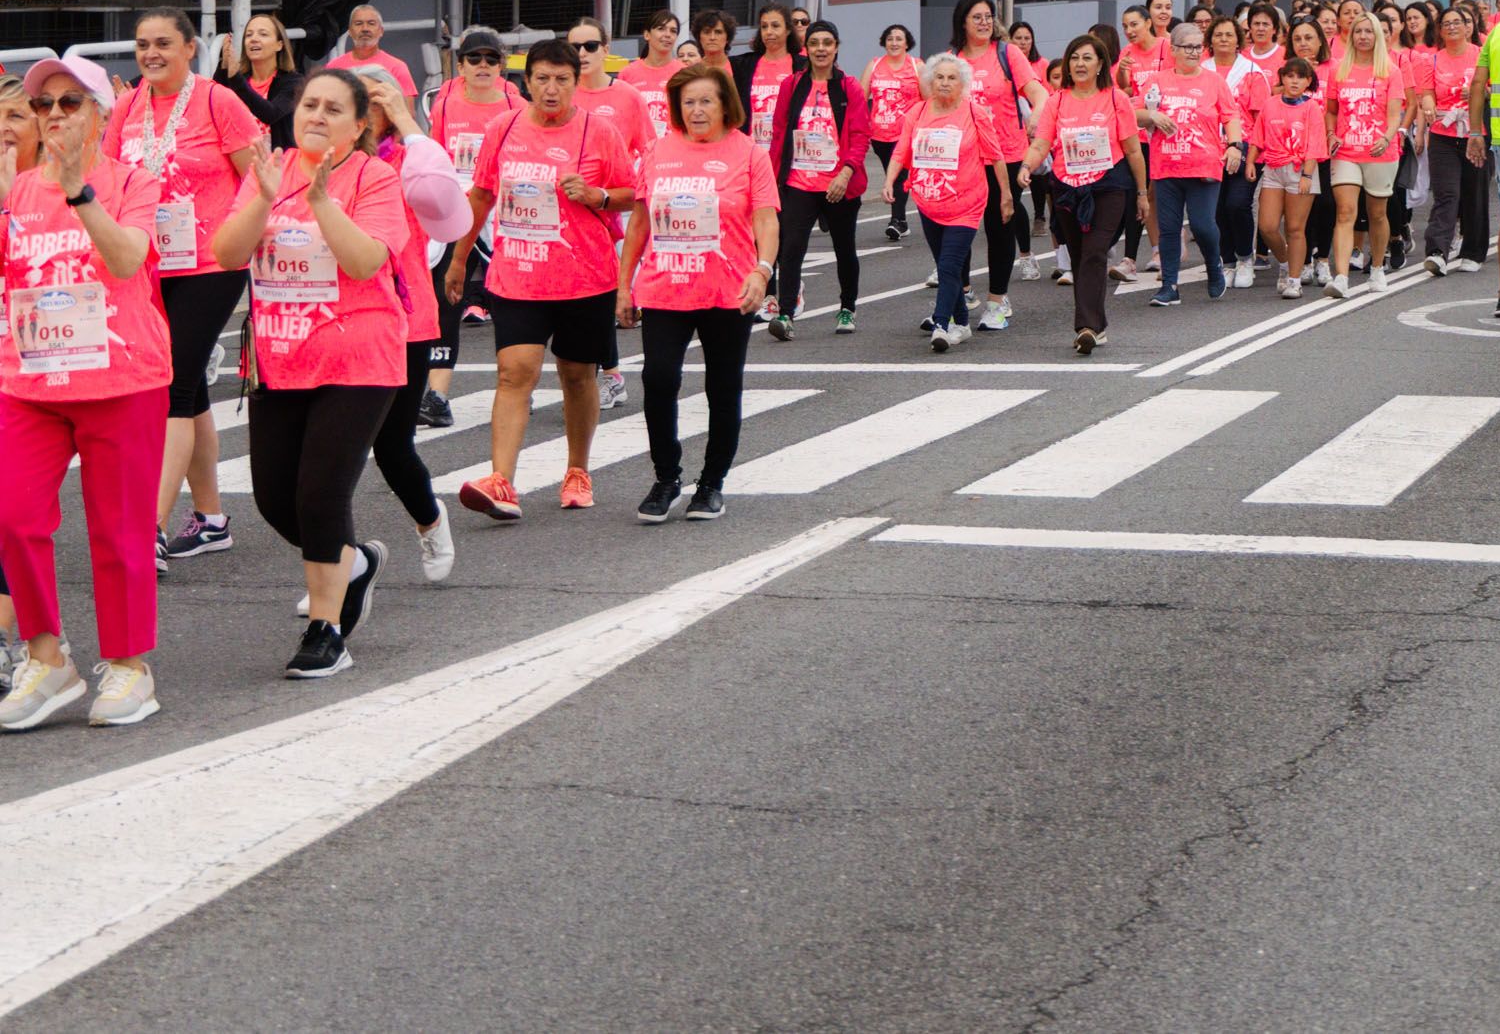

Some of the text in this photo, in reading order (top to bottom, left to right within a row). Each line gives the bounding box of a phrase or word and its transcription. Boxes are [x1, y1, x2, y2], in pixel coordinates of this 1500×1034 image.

[502, 161, 557, 182] CARRERA
[654, 176, 716, 193] CARRERA
[515, 207, 538, 218] 016
[672, 220, 697, 230] 016
[9, 230, 92, 260] CARRERA
[503, 242, 549, 262] MUJER
[277, 260, 310, 273] 016
[657, 255, 706, 273] MUJER
[671, 274, 689, 284] 2026
[39, 325, 74, 340] 016
[255, 314, 312, 340] MUJER
[271, 340, 290, 354] 2026
[47, 372, 71, 386] 2026
